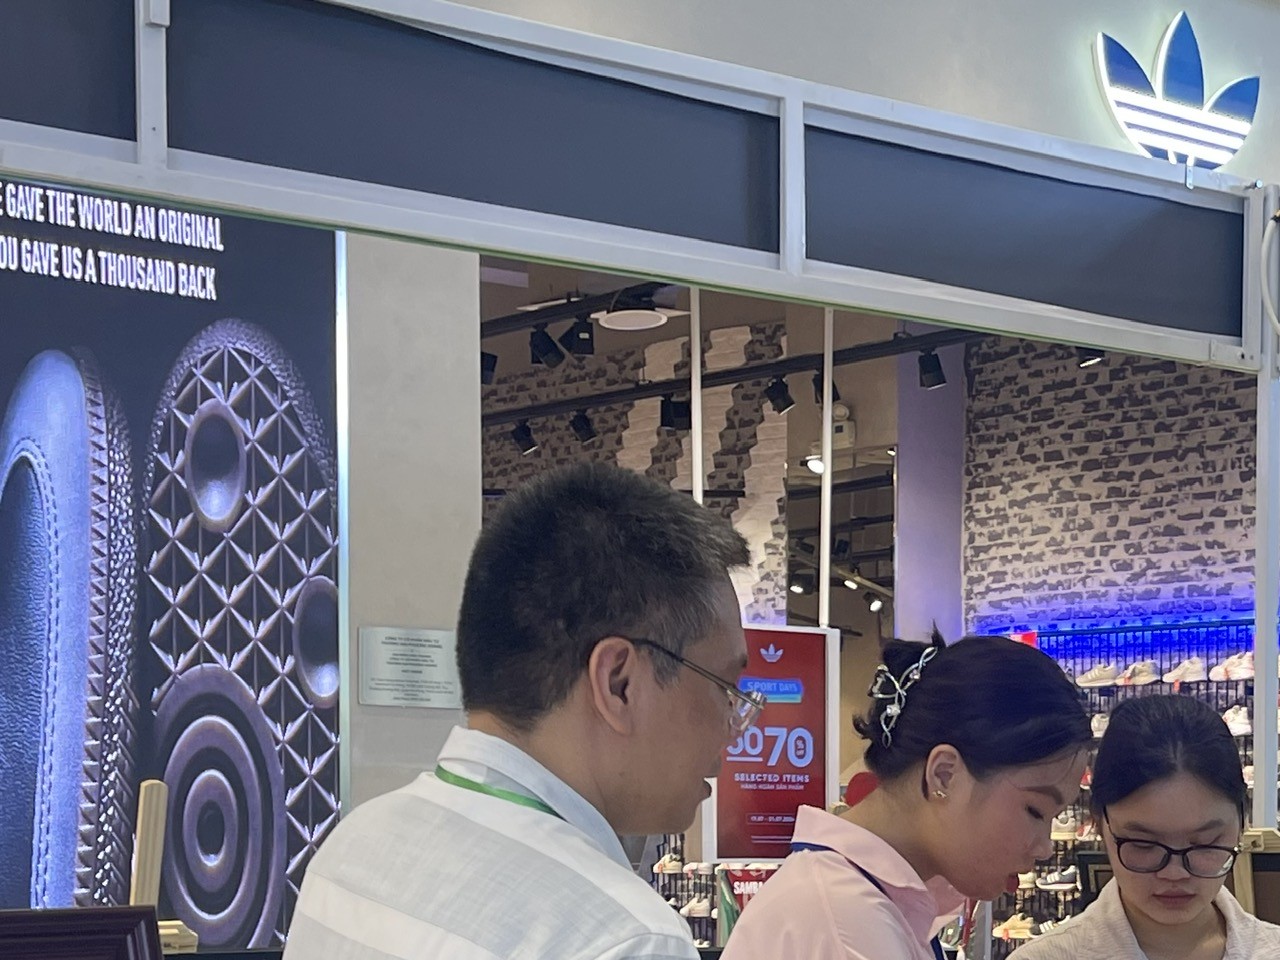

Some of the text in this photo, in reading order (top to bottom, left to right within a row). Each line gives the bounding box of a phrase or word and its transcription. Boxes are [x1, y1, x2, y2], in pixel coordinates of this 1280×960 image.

[5, 183, 45, 223] GAVE
[46, 189, 76, 227] THE
[77, 194, 132, 236] WORLD
[134, 205, 155, 240] AN
[158, 207, 224, 251] ORIGINAL
[21, 239, 59, 277] GAVE
[61, 245, 82, 280] US
[84, 249, 97, 283] A
[98, 251, 175, 294] THOUSAND
[178, 263, 217, 301] BACK
[747, 681, 798, 692] SPORT DAYS
[764, 727, 814, 768] 70
[734, 773, 810, 783] SELECTED ITEMS
